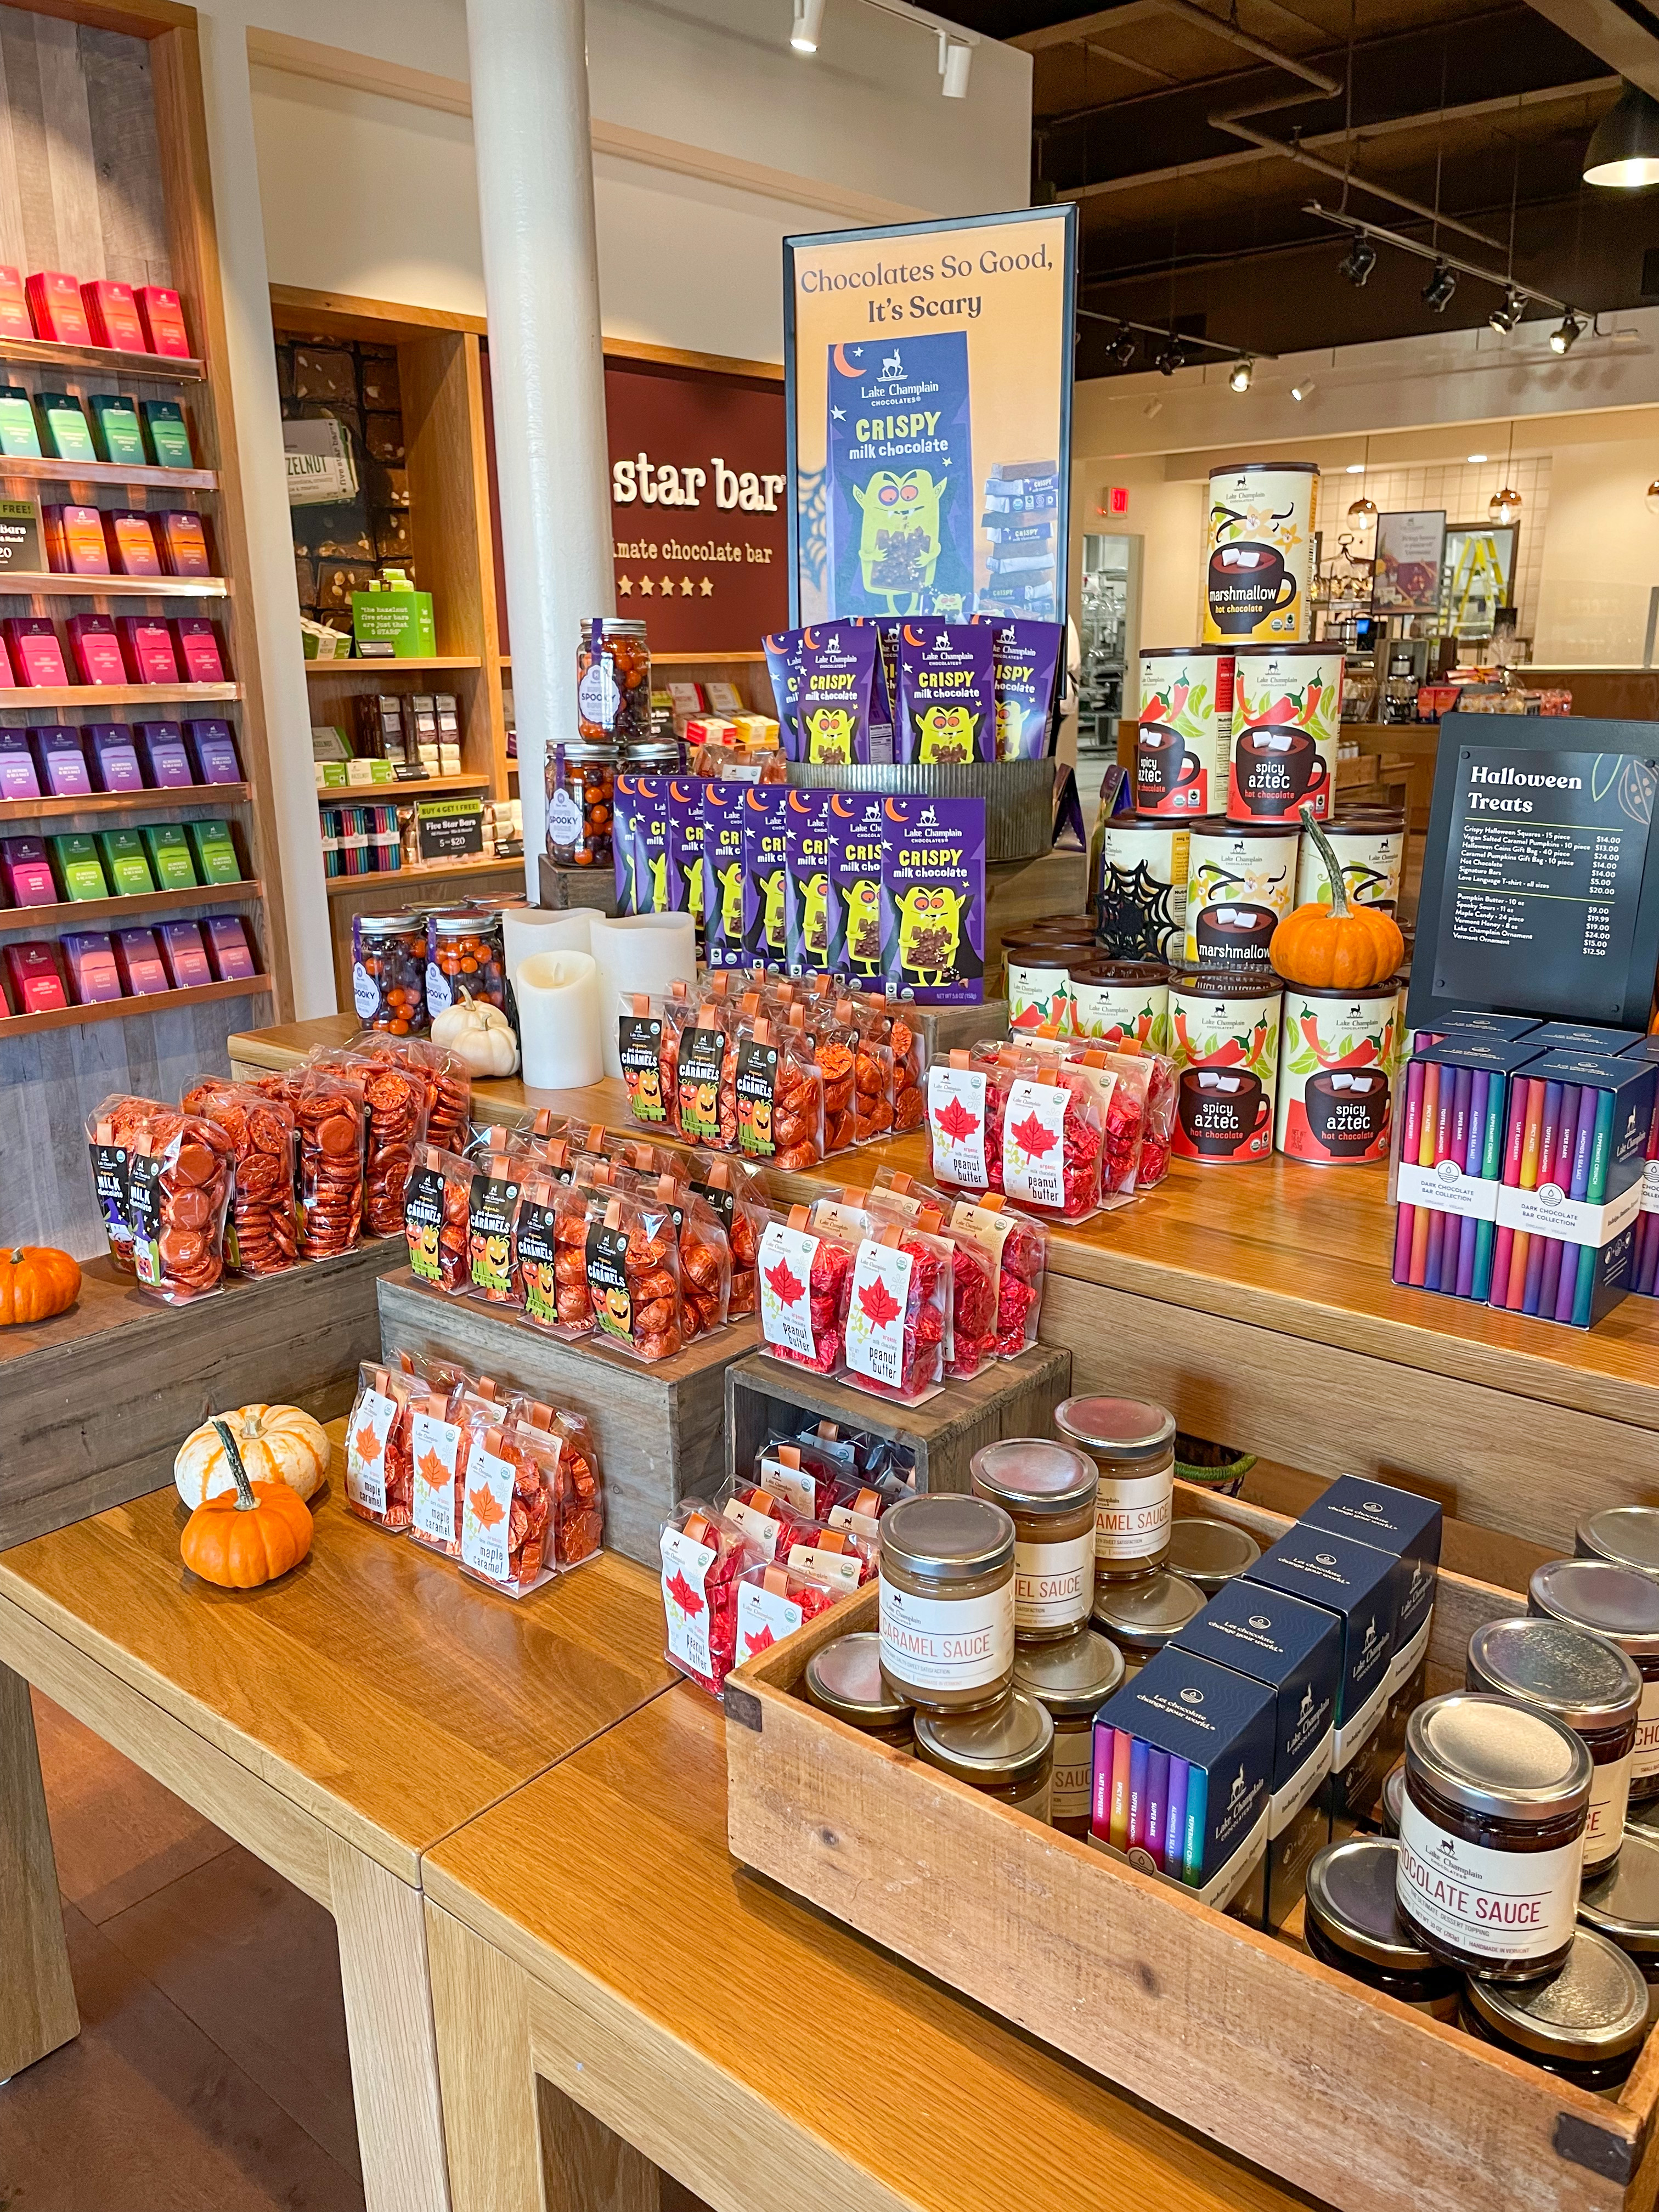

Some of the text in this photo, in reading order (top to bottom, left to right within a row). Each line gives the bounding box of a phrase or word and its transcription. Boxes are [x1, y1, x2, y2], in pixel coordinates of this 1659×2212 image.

[801, 244, 1053, 294] Chocolates So Good,
[868, 292, 982, 323] It's Scary
[861, 381, 939, 399] Lake Champlain
[856, 411, 941, 442] CRISPY
[849, 438, 949, 460] milk chocolate
[613, 453, 706, 505] star
[2, 505, 31, 514] FREE!
[0, 523, 26, 535] Bars
[662, 539, 742, 562] chocolate
[744, 543, 772, 563] bar
[1209, 584, 1277, 602] marshmallow
[1215, 603, 1263, 613] hot chocolate
[922, 652, 974, 661] Lake Champlain
[810, 674, 856, 690] CRISPY
[918, 671, 975, 688] CRISPY
[582, 693, 616, 702] SPOOY
[805, 691, 858, 701] milk chocolate
[914, 688, 980, 699] milk chocolate
[1255, 763, 1285, 776] spicy
[1470, 766, 1582, 790] Halloween
[1248, 774, 1290, 789] aztec
[1244, 789, 1295, 799] hot chocolate
[1468, 792, 1533, 813] Treats
[426, 819, 476, 831] Five Star Bars
[904, 828, 962, 838] Lake Champlain
[439, 836, 466, 848] 5 $20
[1463, 833, 1481, 842] Vegan
[1482, 835, 1502, 843] Salted
[1502, 836, 1528, 845] Caramel
[1529, 838, 1560, 848] Pumpkins
[1573, 843, 1591, 851] piece
[1595, 844, 1619, 853] $13.00
[1464, 825, 1484, 834] Crispy
[1485, 827, 1516, 836] Halloween
[1516, 829, 1541, 838] Squares
[1554, 833, 1571, 841] piece
[1596, 836, 1621, 844] $14.00
[899, 849, 963, 866] CRISPY
[1461, 849, 1486, 858] Caramel
[1487, 851, 1517, 861] Pumpkins
[1517, 854, 1531, 862] Gift
[1532, 856, 1544, 865] Bag
[1557, 859, 1575, 867] piece
[1593, 861, 1617, 870] $14.00
[1462, 841, 1493, 850] Halloween
[1512, 845, 1525, 854] Gift
[1526, 847, 1538, 856] Bag
[1553, 849, 1571, 858] piece
[1594, 853, 1620, 861] $24.00
[893, 867, 967, 878] milk chocolate
[1458, 865, 1487, 874] Signature
[1590, 878, 1611, 887] $5.00
[1472, 859, 1503, 868] Chocolate
[1592, 870, 1616, 878] $14.00
[1472, 875, 1501, 885] Language
[1589, 886, 1615, 895] $20.00
[1457, 893, 1484, 902] Pumpkin
[1485, 895, 1505, 904] Butter
[1588, 906, 1609, 915] $9.00
[1198, 942, 1270, 961] marshmallow
[737, 1078, 772, 1098] CARAMELS
[1203, 1102, 1233, 1116] spicy
[1194, 1114, 1239, 1129] aztec
[1190, 1127, 1244, 1139] hot chocolate
[97, 1176, 121, 1191] MILK
[1028, 1176, 1057, 1189] peanut
[1421, 1180, 1474, 1196] DARK CHOCOLATE
[98, 1187, 123, 1198] chocolate
[1032, 1187, 1059, 1202] butter
[1435, 1190, 1472, 1202] COLLECTION
[1521, 1204, 1578, 1221] DARK CHOCOLATE
[1536, 1213, 1576, 1227] COLLECTION
[588, 1265, 626, 1288] CARAMELS
[869, 1346, 896, 1365] peanut
[872, 1358, 897, 1380] butter
[1137, 1502, 1169, 1529] SAUCE
[479, 1545, 504, 1562] maple
[473, 1555, 503, 1574] caramel
[883, 1617, 990, 1658] CARAMEL SAUCE
[1137, 1694, 1166, 1709] change
[1165, 1706, 1186, 1718] your
[1154, 1694, 1207, 1721] Let chocolate
[1215, 1778, 1264, 1839] Lake Champlain
[1425, 1844, 1483, 1880] Lake Champlain
[1417, 1893, 1490, 1937] ULTIMATE DESSERT TOPPING
[1475, 1897, 1542, 1924] SAUCE
[1469, 1940, 1499, 1954] HANDMADE
